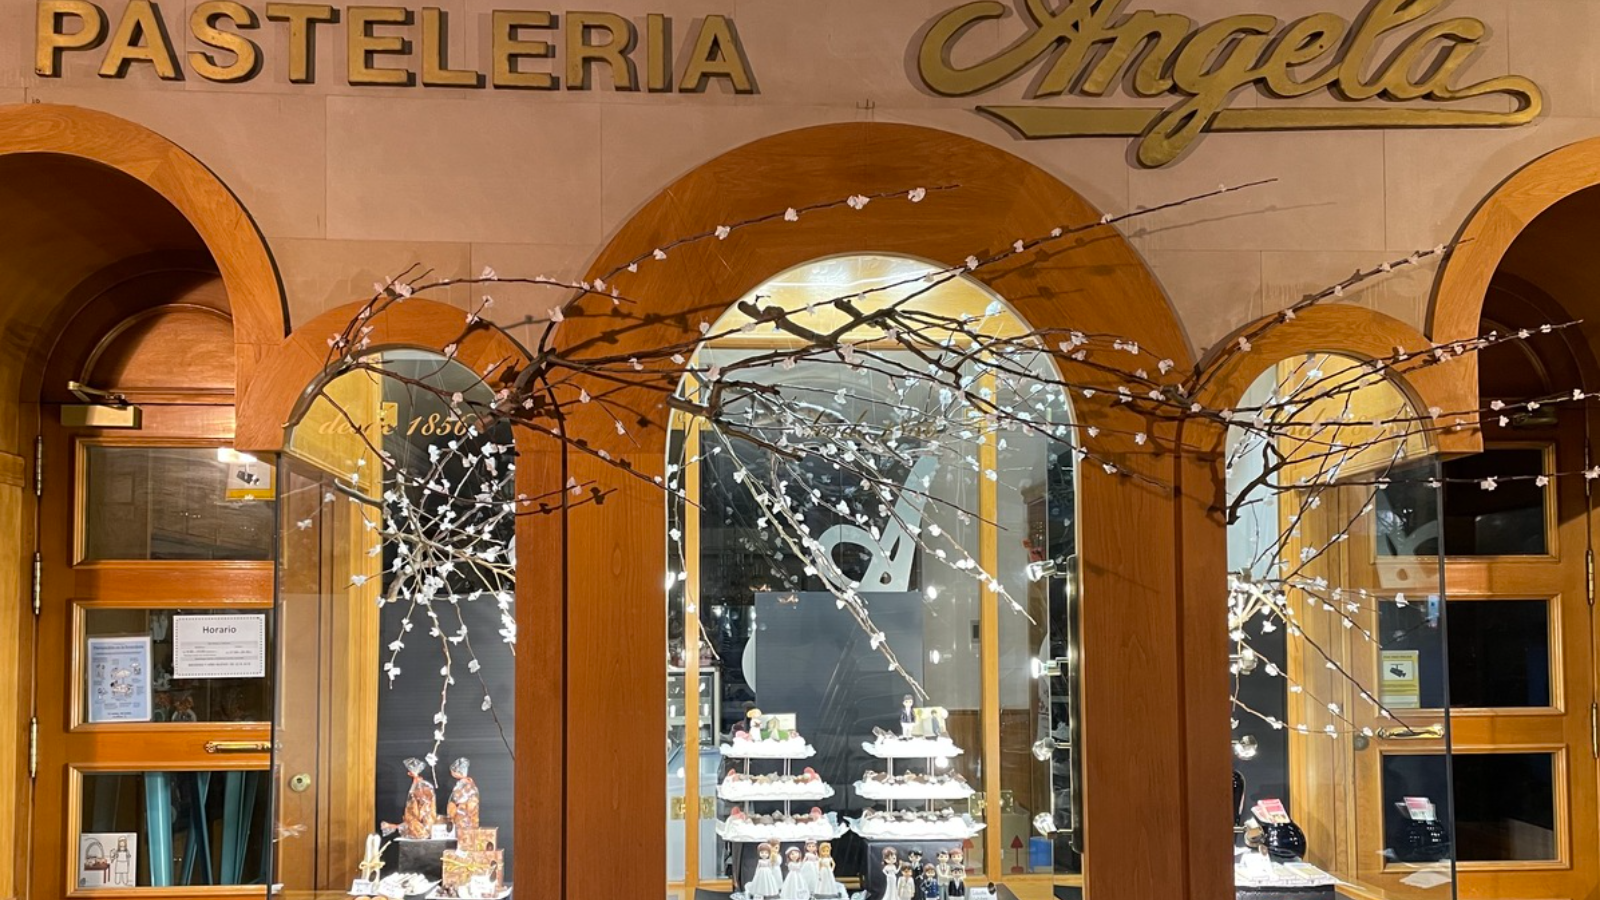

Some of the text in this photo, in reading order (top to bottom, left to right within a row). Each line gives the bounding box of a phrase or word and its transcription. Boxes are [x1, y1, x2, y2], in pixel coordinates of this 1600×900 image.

[35, 0, 760, 94] PASTELERIA
[918, 0, 1544, 168] Angela
[406, 413, 478, 436] 1856
[202, 625, 237, 634] Horario
